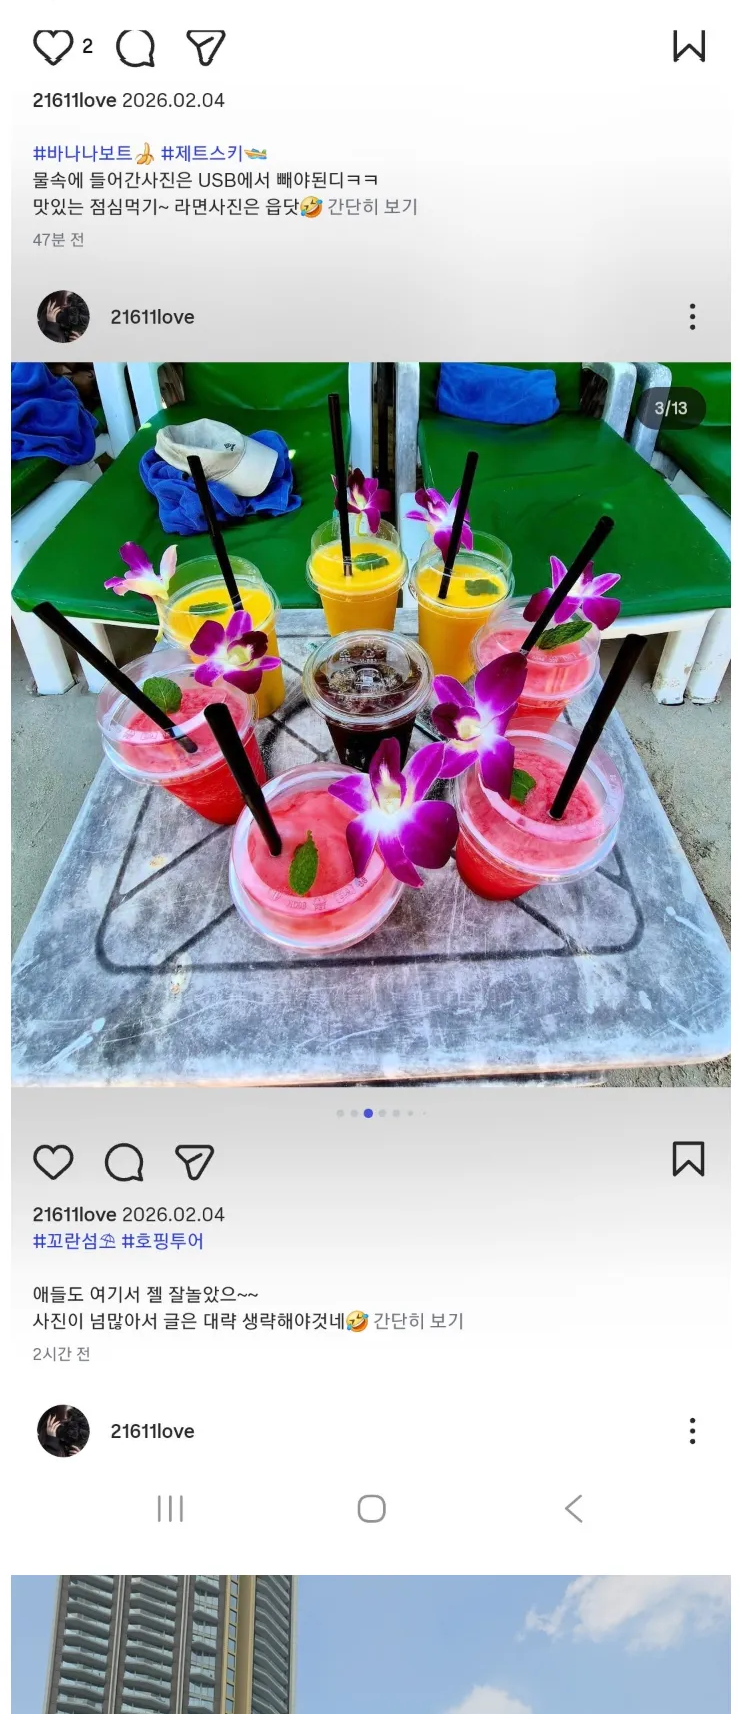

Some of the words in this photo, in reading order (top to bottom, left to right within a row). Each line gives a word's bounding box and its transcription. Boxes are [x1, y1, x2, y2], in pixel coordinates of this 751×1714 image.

[33, 92, 117, 107] 21611love
[122, 92, 225, 107] 2026.02.04
[33, 145, 132, 162] #바나나보트
[161, 145, 241, 162] #제트스키
[33, 172, 82, 189] 물속에
[90, 172, 192, 189] 들어간사진은
[199, 172, 269, 189] USB에서
[34, 199, 83, 215] 맛있는
[175, 198, 259, 215] 라면사진은
[266, 198, 299, 215] 읍닷
[329, 199, 377, 215] 간단히
[384, 199, 416, 215] 보기
[112, 309, 194, 324] 21611love
[654, 400, 688, 417] 3/13
[33, 1207, 117, 1222] 21611love
[122, 1207, 225, 1222] 2026.02.04
[34, 1233, 96, 1249] #꼬란섬
[122, 1233, 202, 1250] #호핑투어
[34, 1286, 83, 1303] 애들도
[91, 1286, 139, 1303] 여기서
[147, 1286, 162, 1303] 젤
[33, 1313, 82, 1330] 사진이
[91, 1313, 156, 1330] 넘많아서
[164, 1313, 196, 1329] 글은
[204, 1313, 236, 1330] 대략
[243, 1313, 344, 1330] 생략해야것네
[375, 1313, 423, 1329] 간단히
[430, 1313, 462, 1329] 보기
[34, 1347, 71, 1361] 2시간
[77, 1347, 89, 1361] 전
[111, 1423, 194, 1438] 21611love
